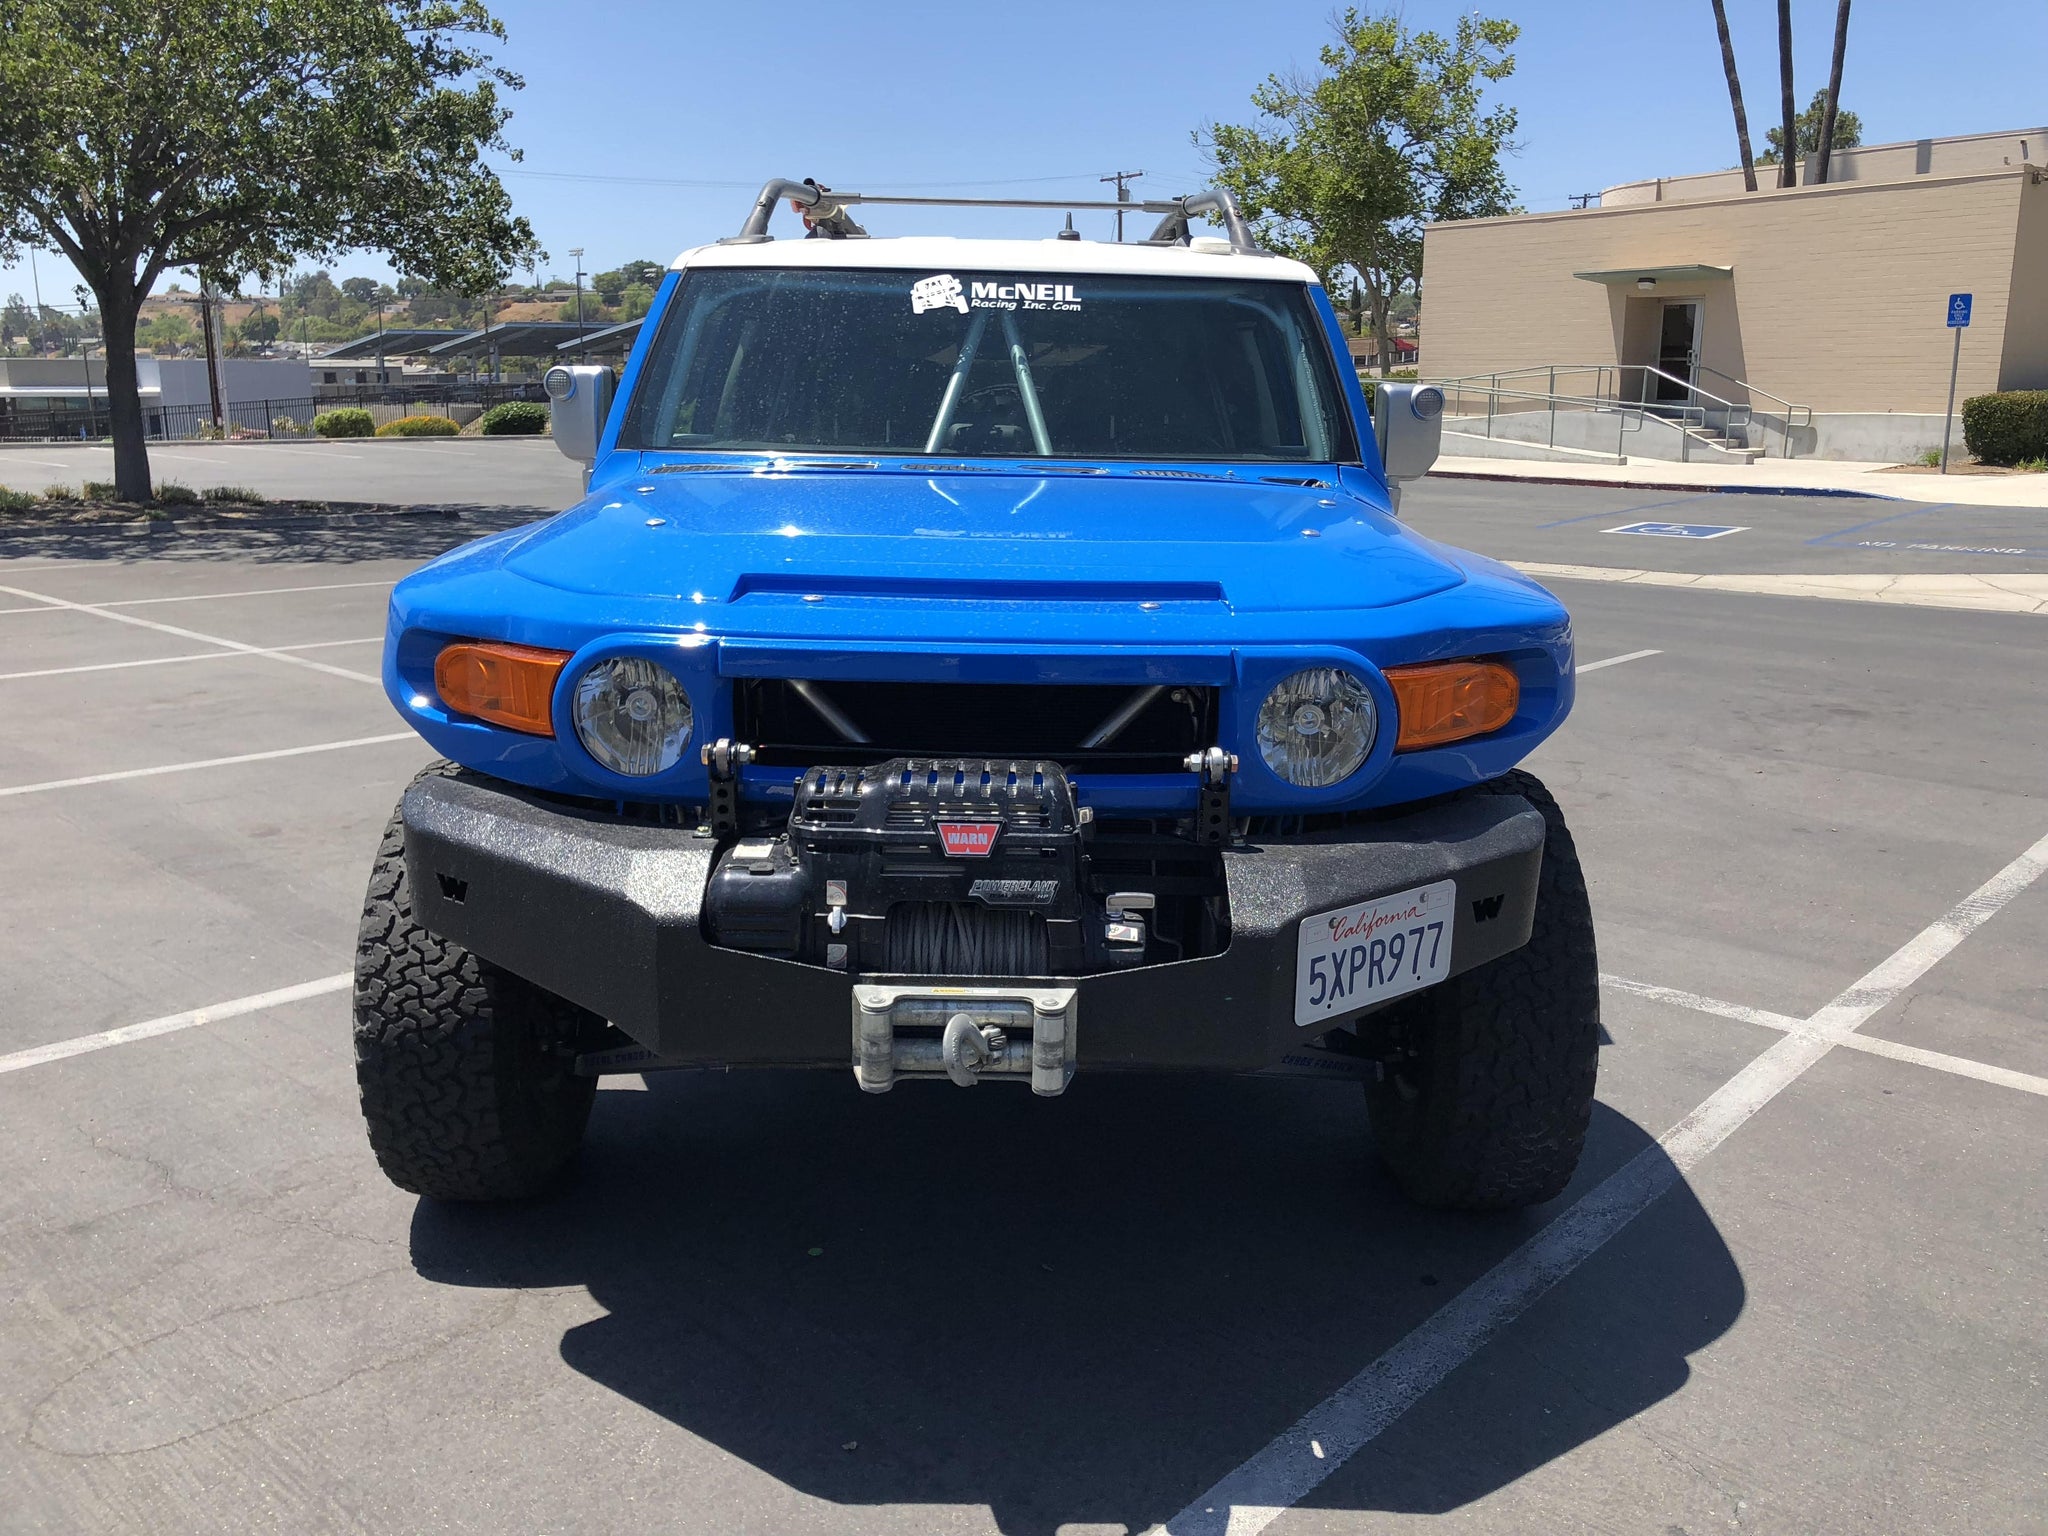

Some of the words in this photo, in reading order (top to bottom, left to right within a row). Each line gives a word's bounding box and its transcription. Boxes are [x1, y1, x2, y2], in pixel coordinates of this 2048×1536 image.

[971, 282, 1082, 301] McNEIL
[971, 299, 1017, 311] Racing
[1906, 543, 2026, 554] PARKING
[948, 833, 988, 844] WARN
[973, 880, 1058, 892] POWERPLANT
[1333, 906, 1427, 942] California
[1309, 921, 1444, 1005] 5XPR977
